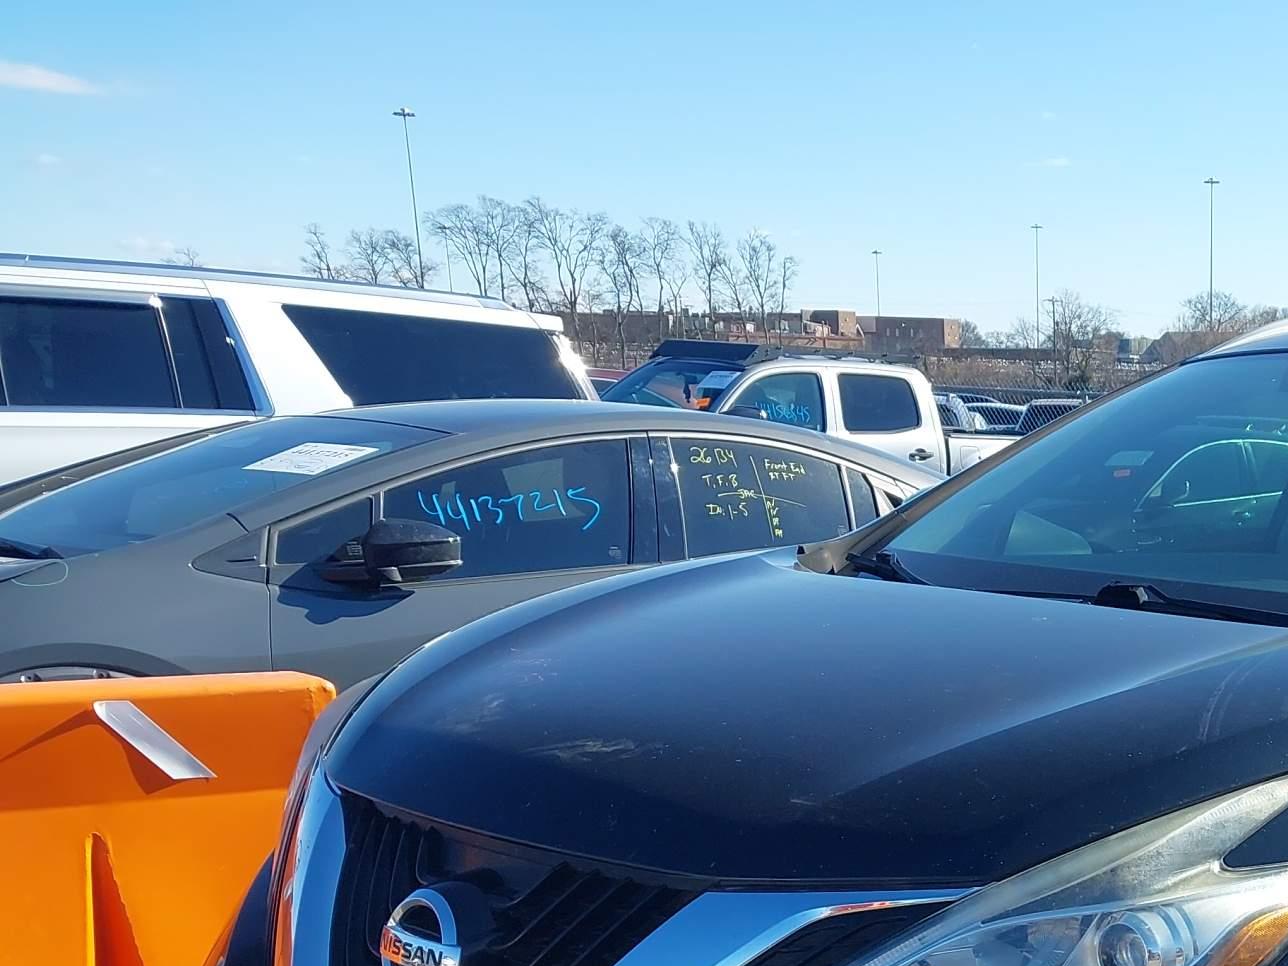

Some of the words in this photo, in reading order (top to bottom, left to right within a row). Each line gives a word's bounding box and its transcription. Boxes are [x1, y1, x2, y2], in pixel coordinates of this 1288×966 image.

[689, 446, 712, 464] 26
[764, 458, 787, 471] Front
[417, 486, 600, 532] 44137215
